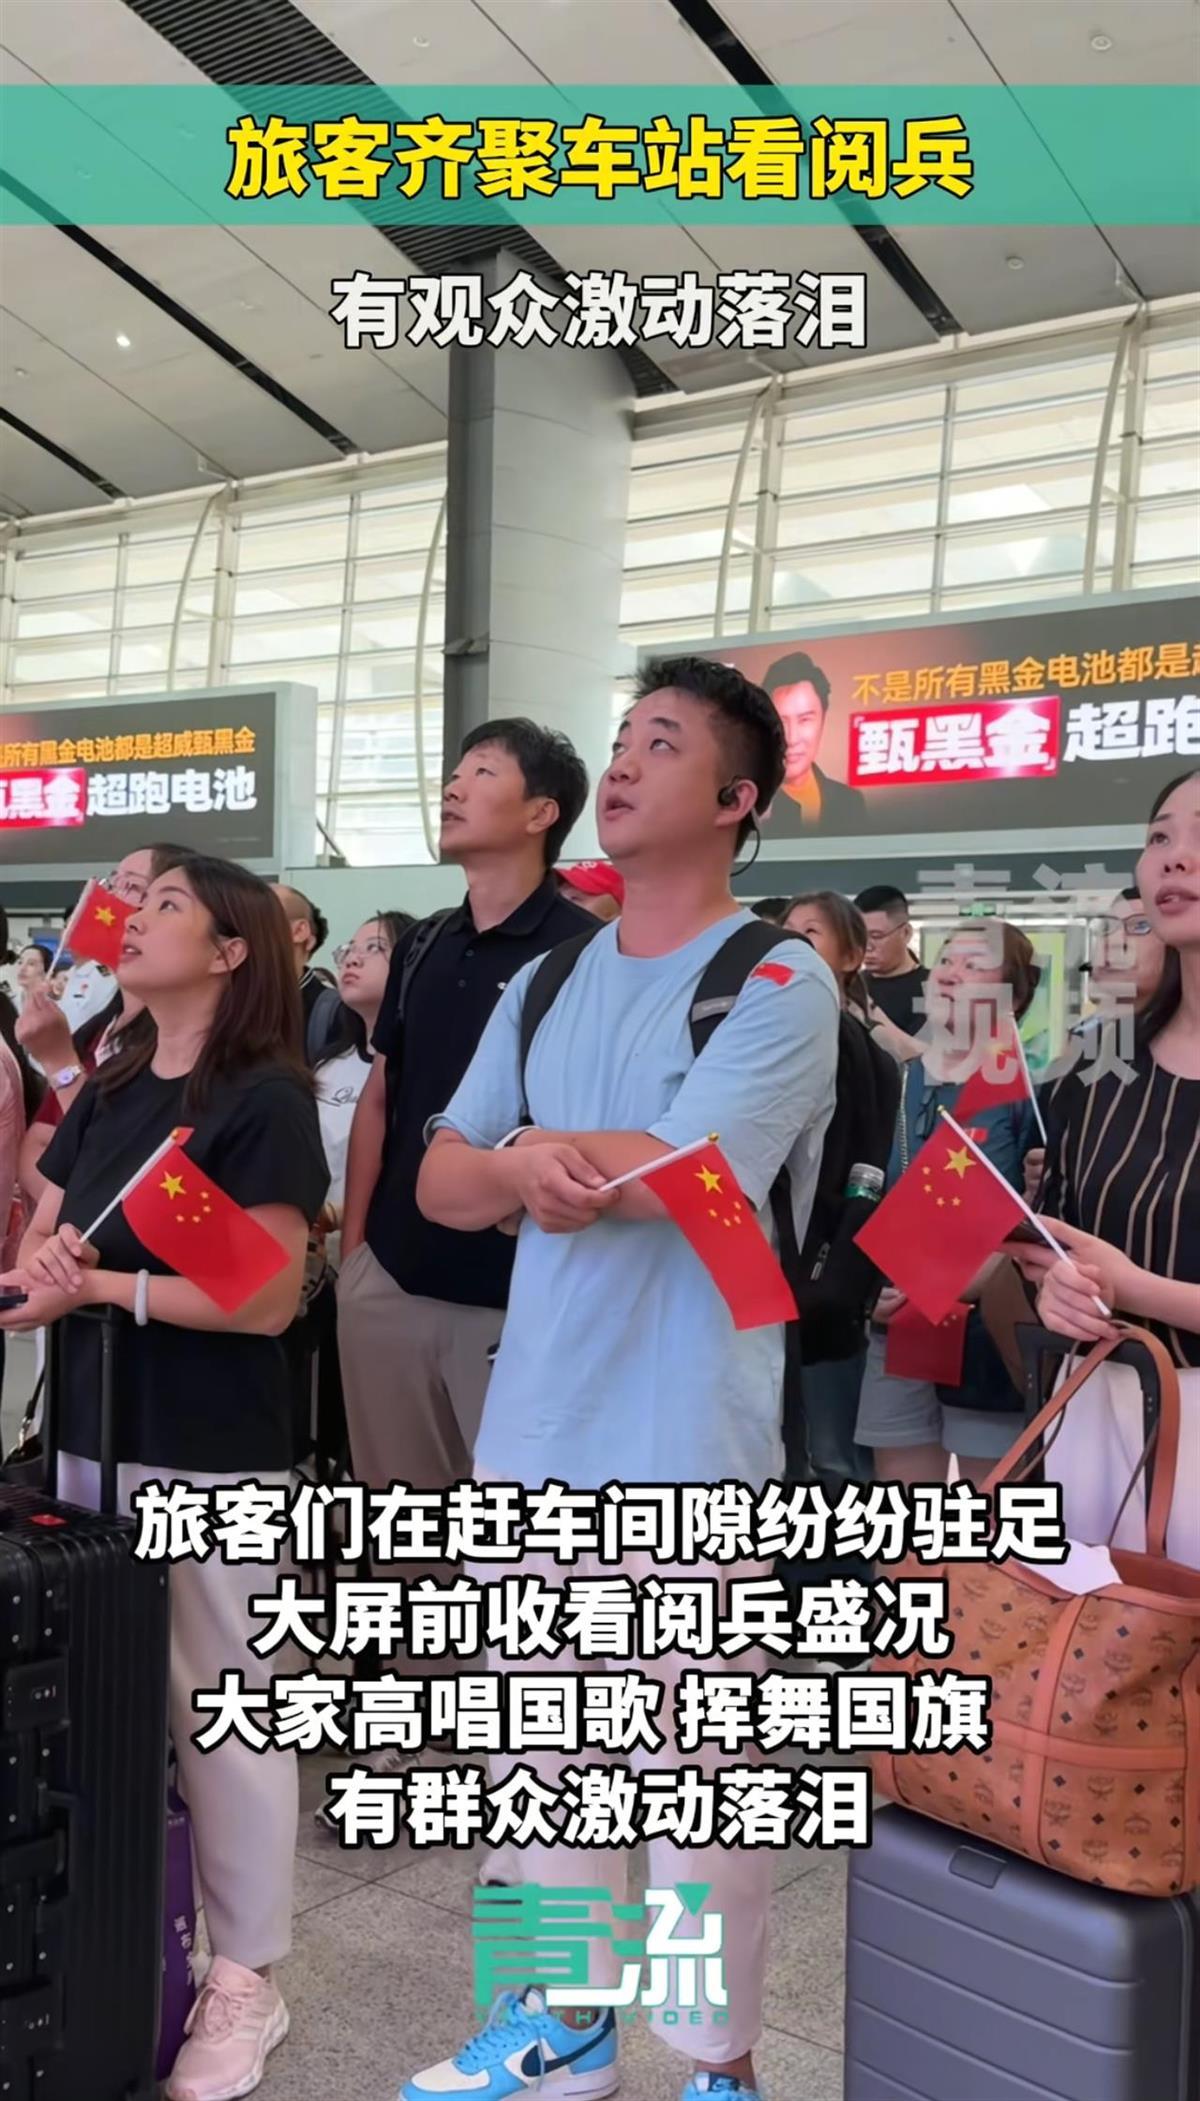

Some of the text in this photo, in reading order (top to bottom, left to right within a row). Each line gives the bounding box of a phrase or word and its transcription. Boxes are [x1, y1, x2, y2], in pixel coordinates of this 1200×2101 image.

[852, 642, 1200, 706] 不是所有黑金电池都是
[0, 726, 256, 768] 所有黑金电池都是超威甄黑金
[87, 765, 258, 817] 超跑电池
